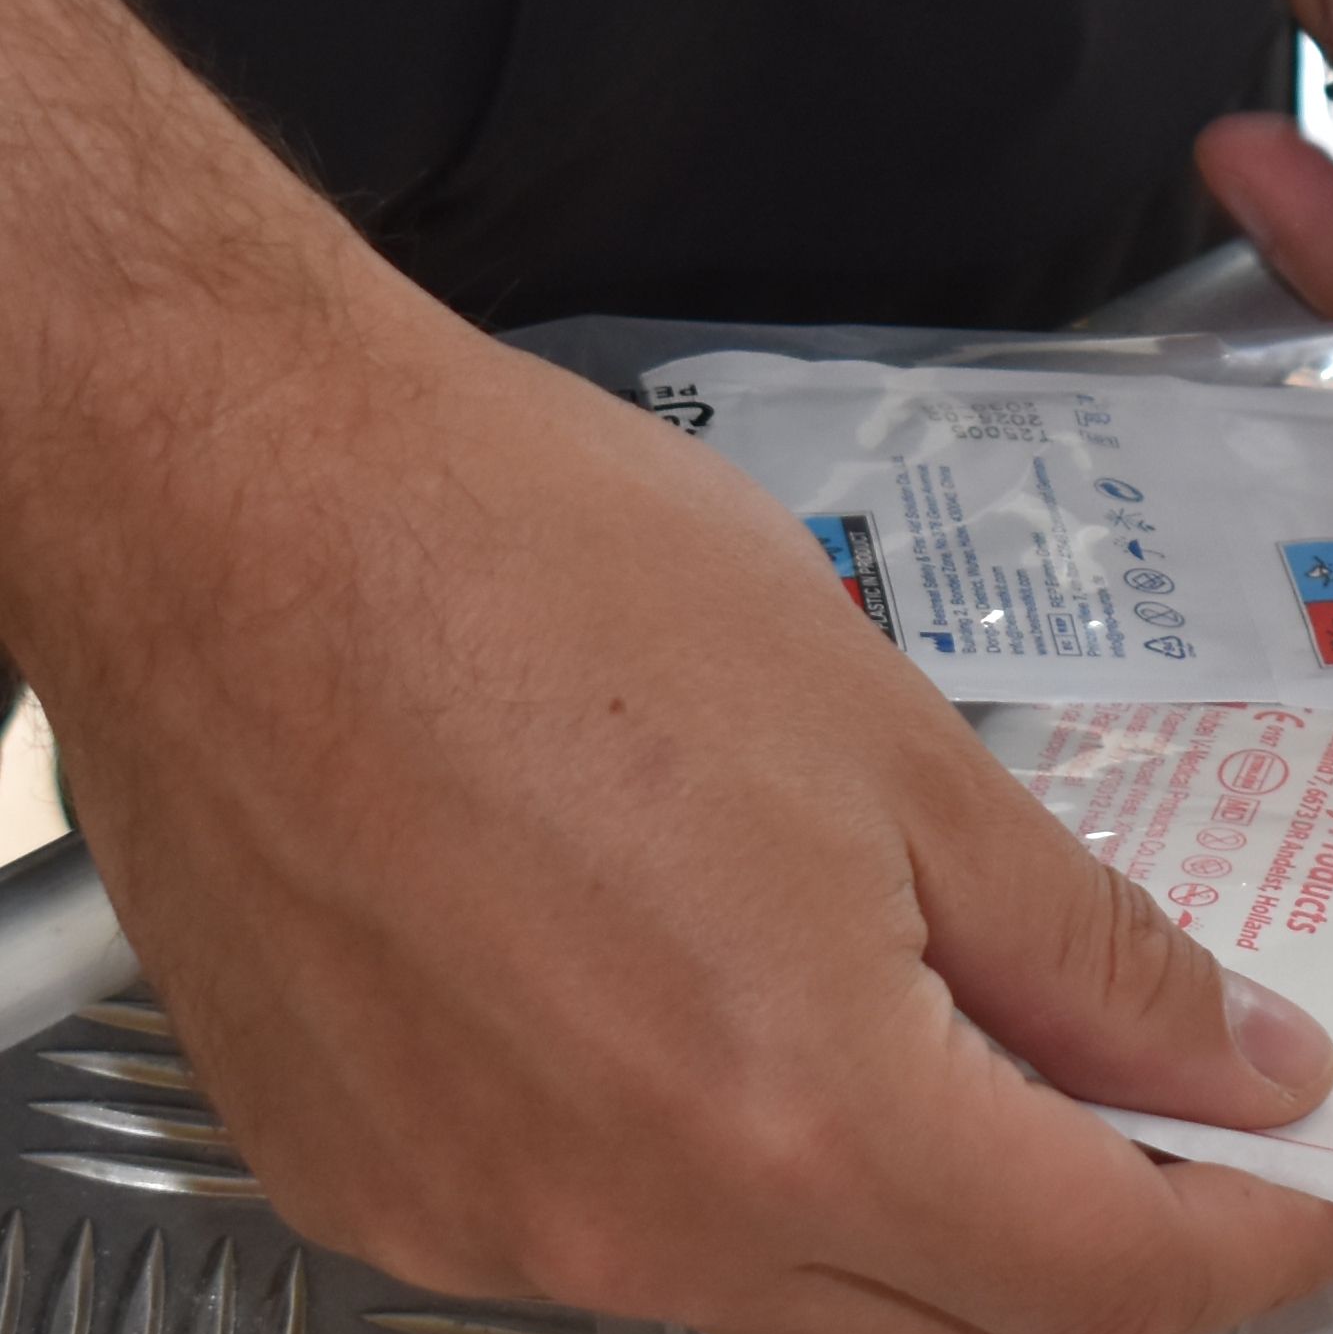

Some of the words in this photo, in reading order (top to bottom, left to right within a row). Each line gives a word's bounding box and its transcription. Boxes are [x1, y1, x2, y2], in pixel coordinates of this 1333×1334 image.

[848, 530, 878, 574] PRODUCT
[860, 575, 879, 586] IN
[1218, 797, 1251, 822] MD
[1295, 788, 1327, 820] 6673
[1284, 818, 1316, 843] DR
[1260, 841, 1303, 891] Andelst,
[1237, 895, 1279, 951] Holland
